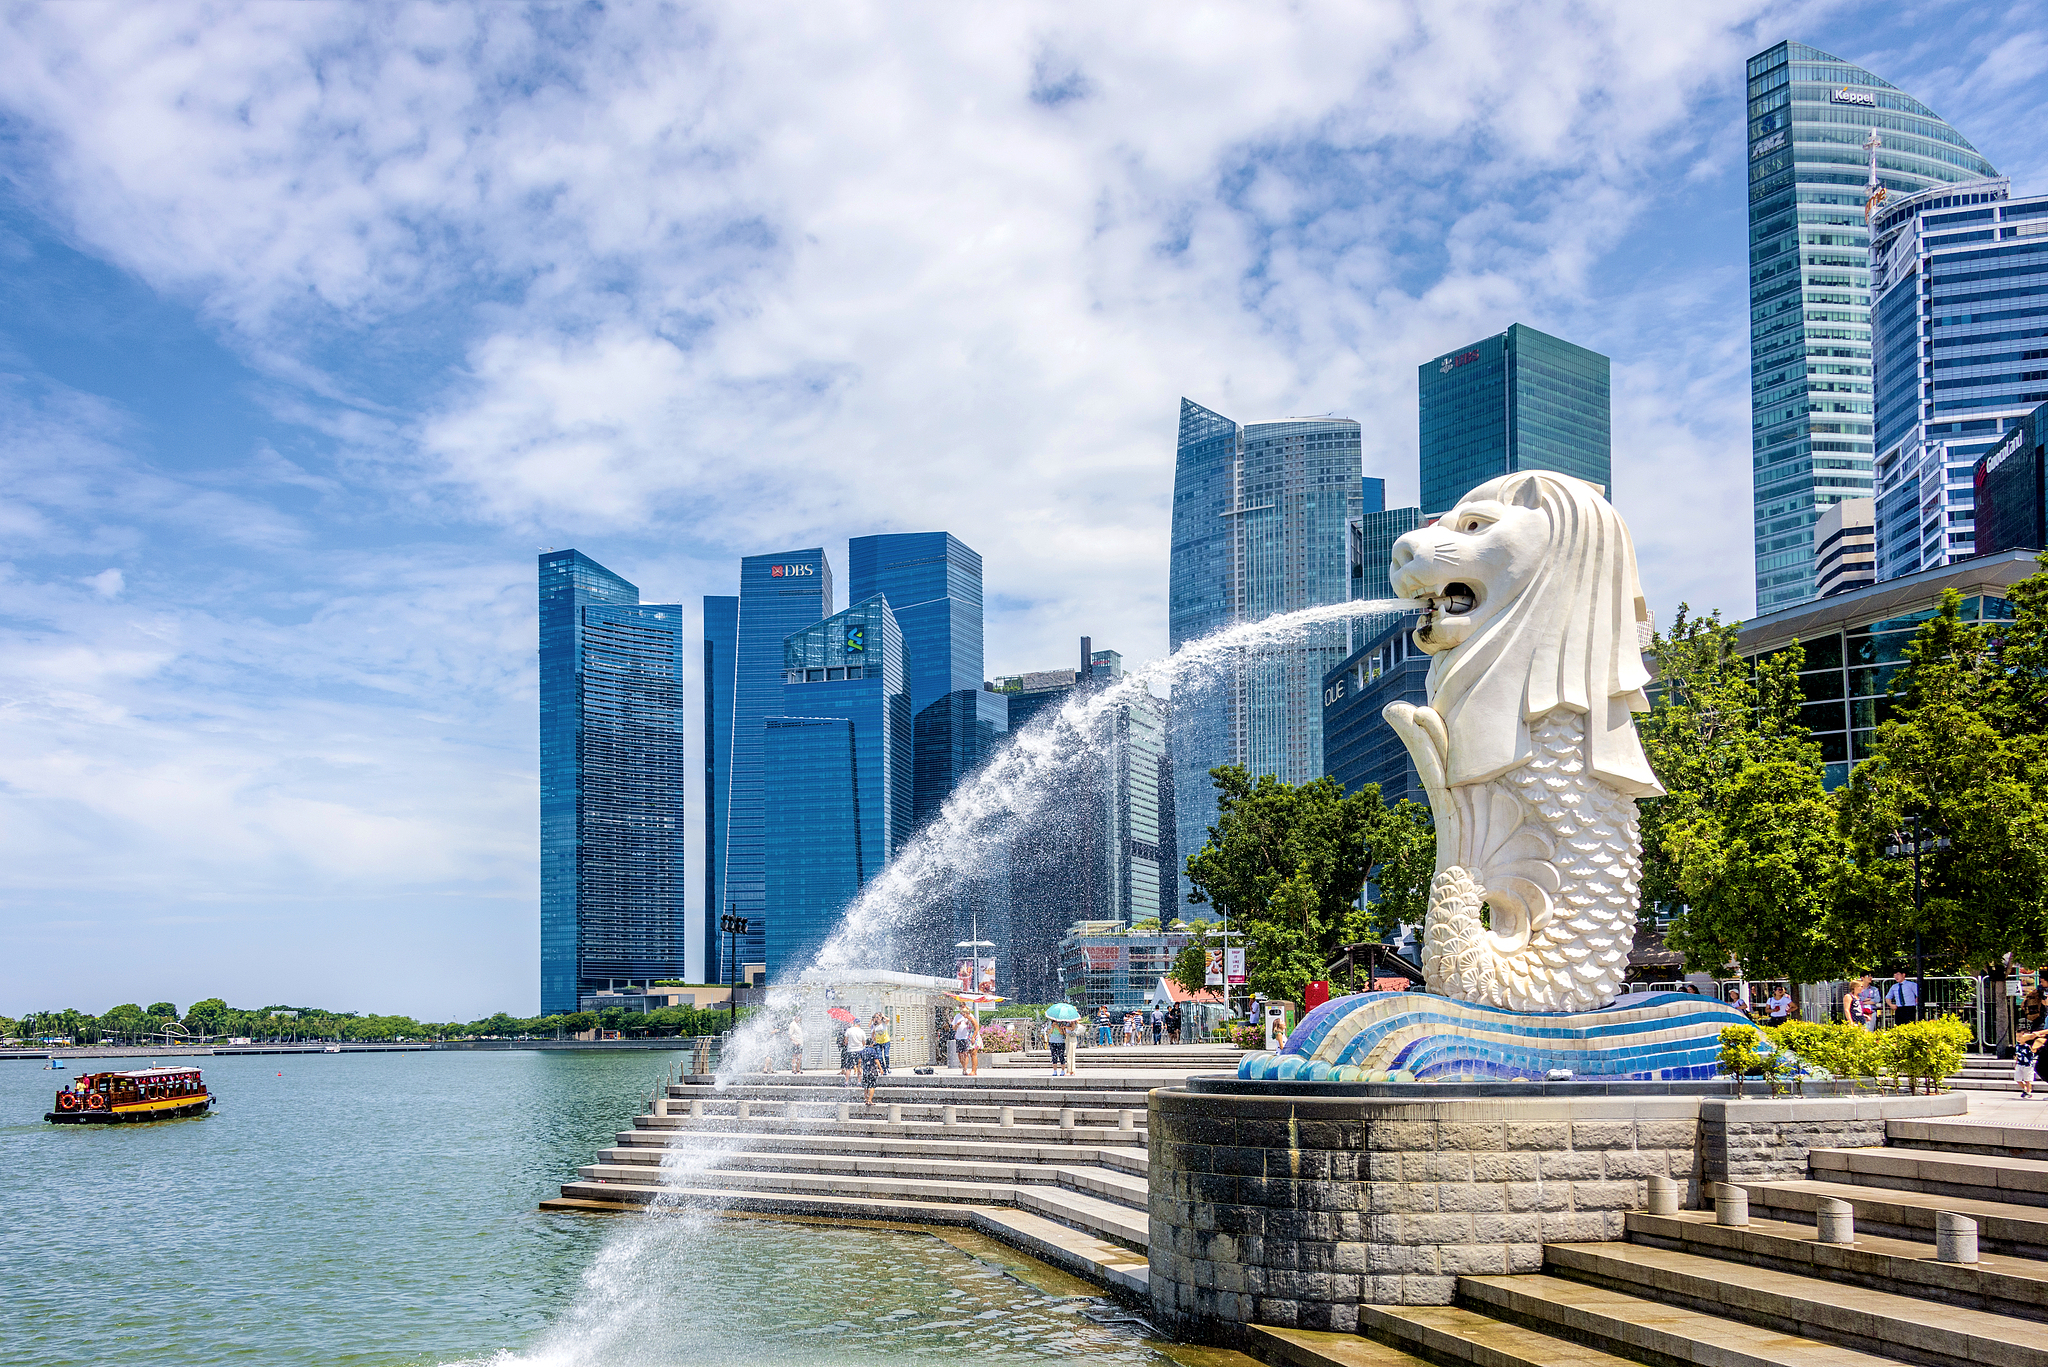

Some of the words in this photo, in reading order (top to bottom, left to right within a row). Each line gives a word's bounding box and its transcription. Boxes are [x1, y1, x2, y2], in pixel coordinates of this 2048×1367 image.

[1835, 88, 1873, 103] Keppel
[1752, 131, 1785, 157] ANZ
[1455, 349, 1479, 367] UBS
[1986, 429, 2023, 473] GuocoLand
[785, 563, 814, 577] DBS
[1325, 680, 1344, 706] OUE
